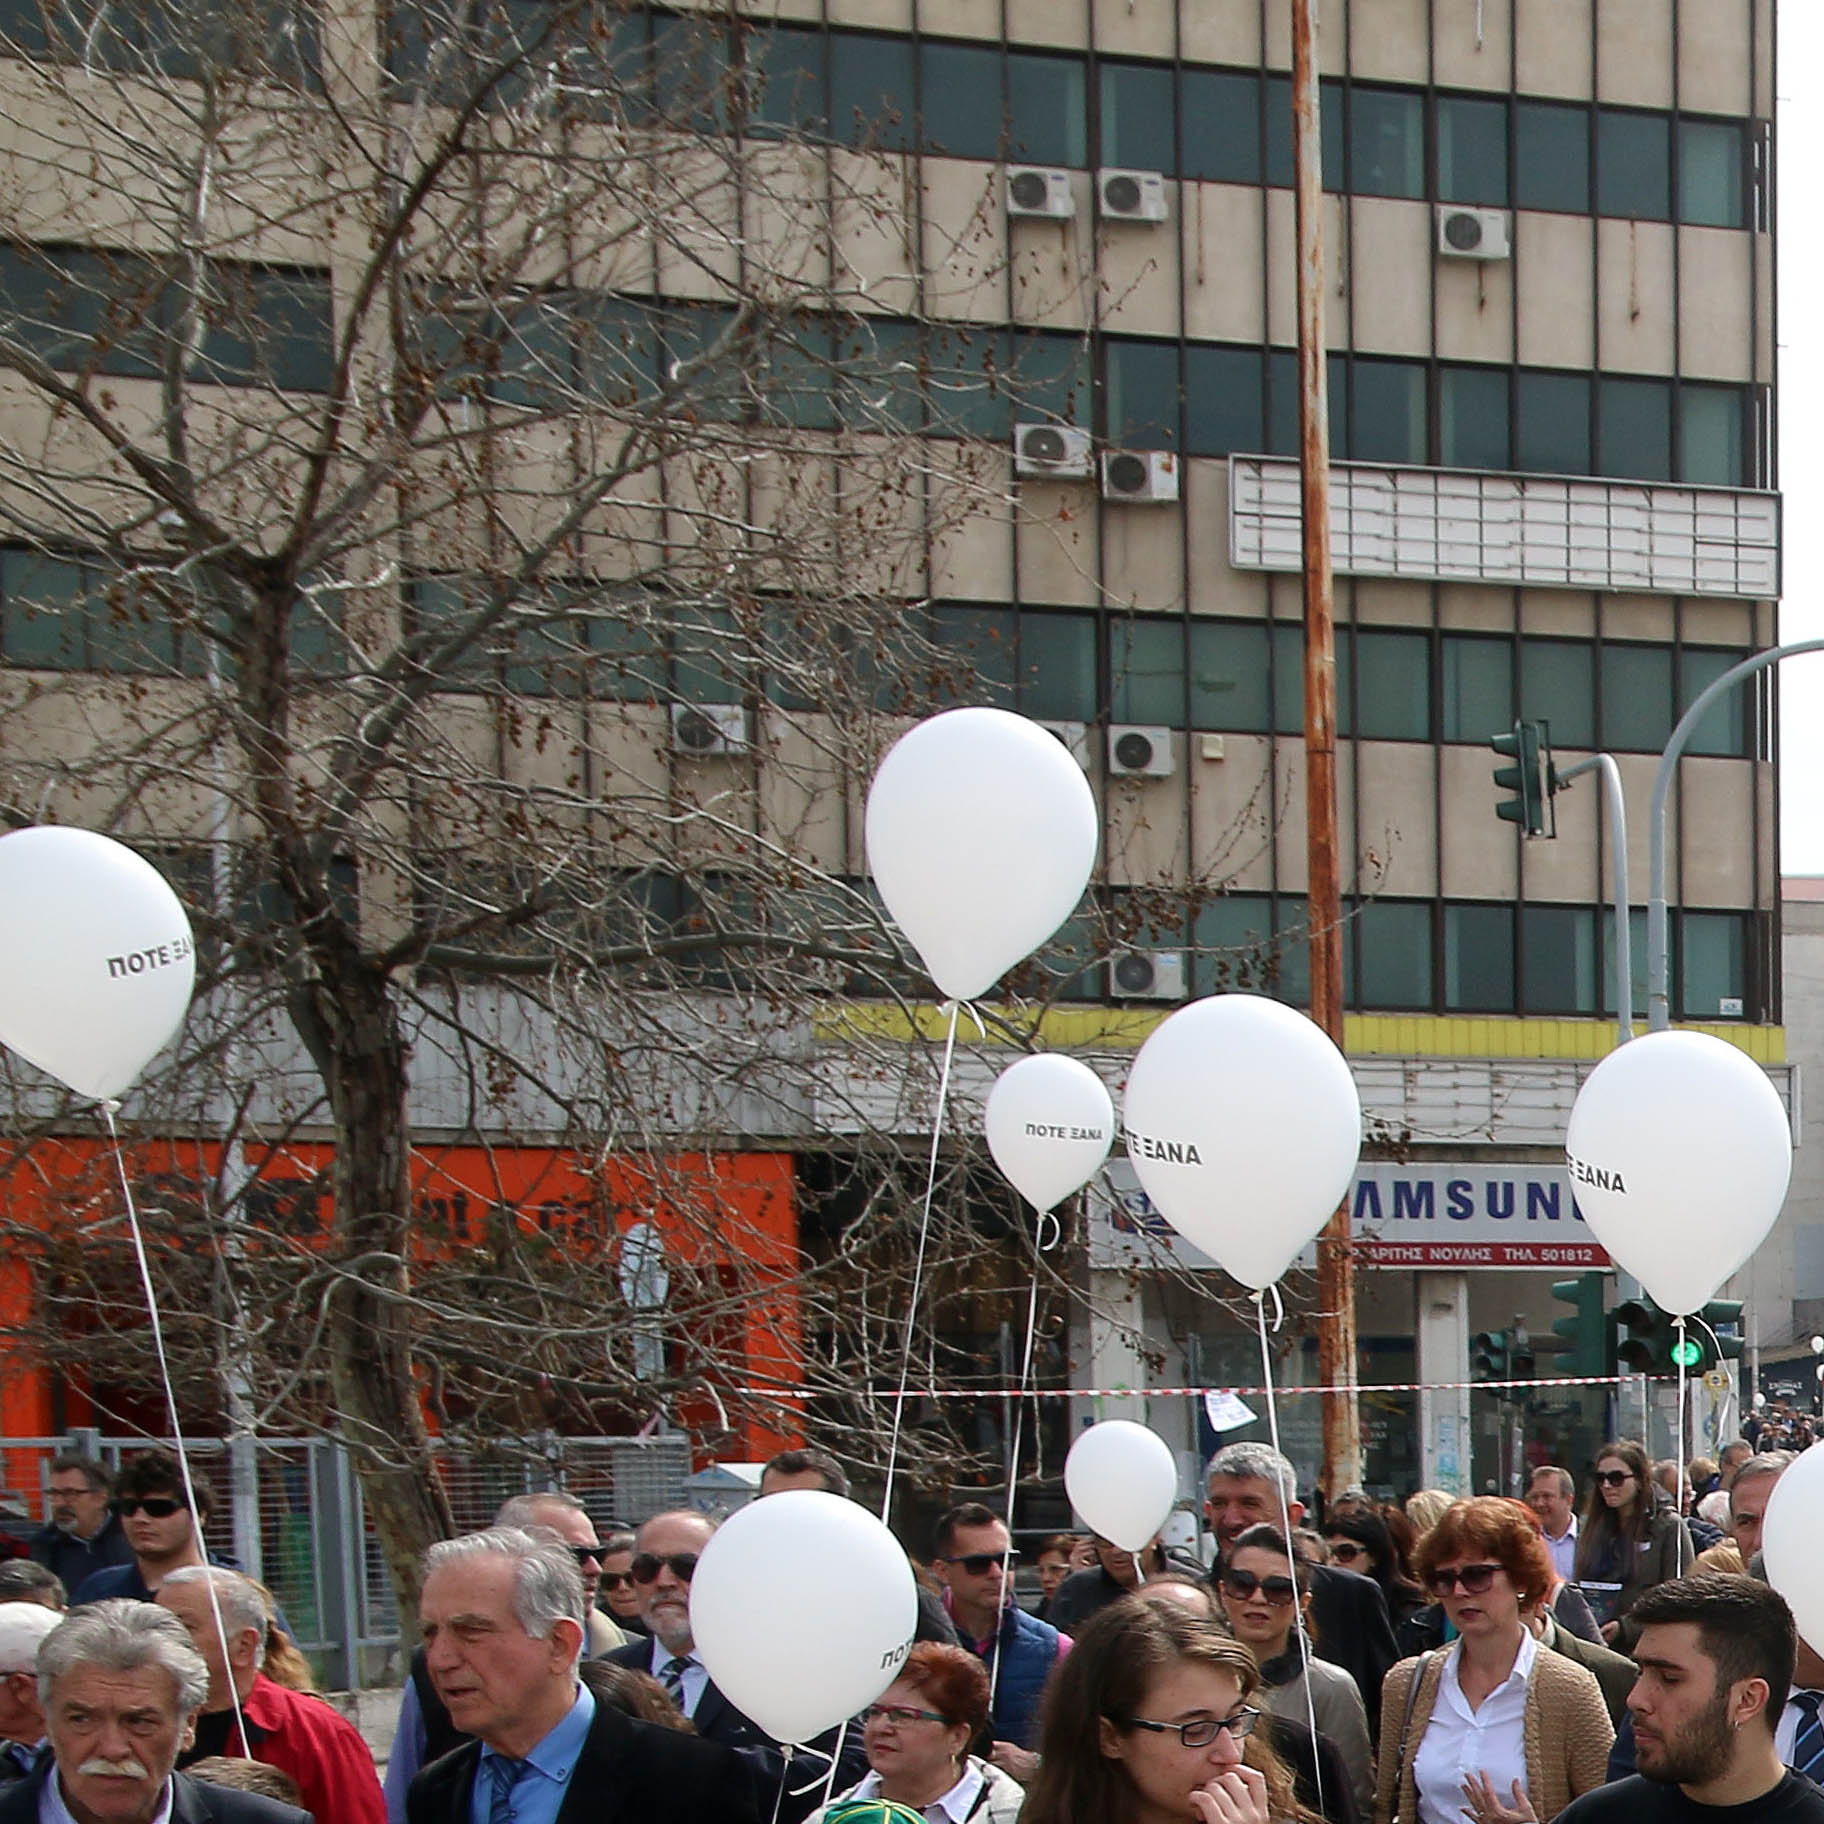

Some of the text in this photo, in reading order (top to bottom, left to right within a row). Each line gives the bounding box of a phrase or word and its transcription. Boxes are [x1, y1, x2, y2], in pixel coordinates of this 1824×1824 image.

[107, 944, 171, 978] ΠΟΤΕ
[1025, 1122, 1103, 1140] ΠΟΤΕ ΞΑΝΑ
[1143, 1136, 1203, 1165] ΞΑΝΑ
[1576, 1159, 1627, 1195] ΞΑΝΑ
[1430, 1247, 1492, 1261] ΝΟΥΛΗΣ
[1541, 1248, 1593, 1261] 501812
